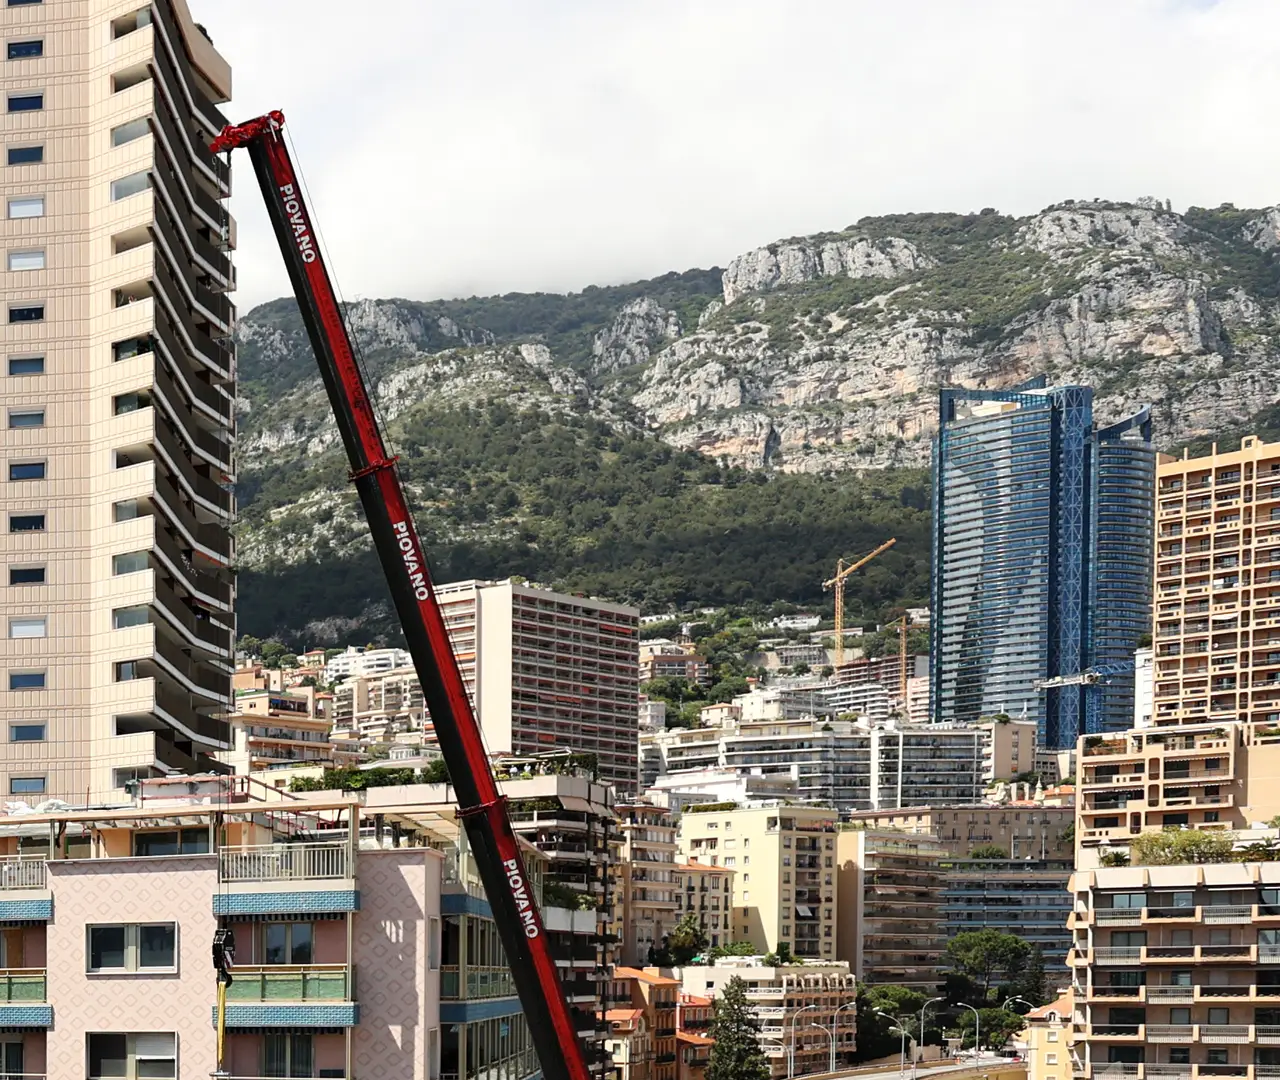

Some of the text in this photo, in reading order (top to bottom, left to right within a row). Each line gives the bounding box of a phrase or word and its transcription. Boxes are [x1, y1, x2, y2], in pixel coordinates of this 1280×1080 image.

[280, 183, 316, 264] PIOVANO
[392, 520, 429, 601] PIOVANO
[503, 858, 539, 939] PIOVANO
